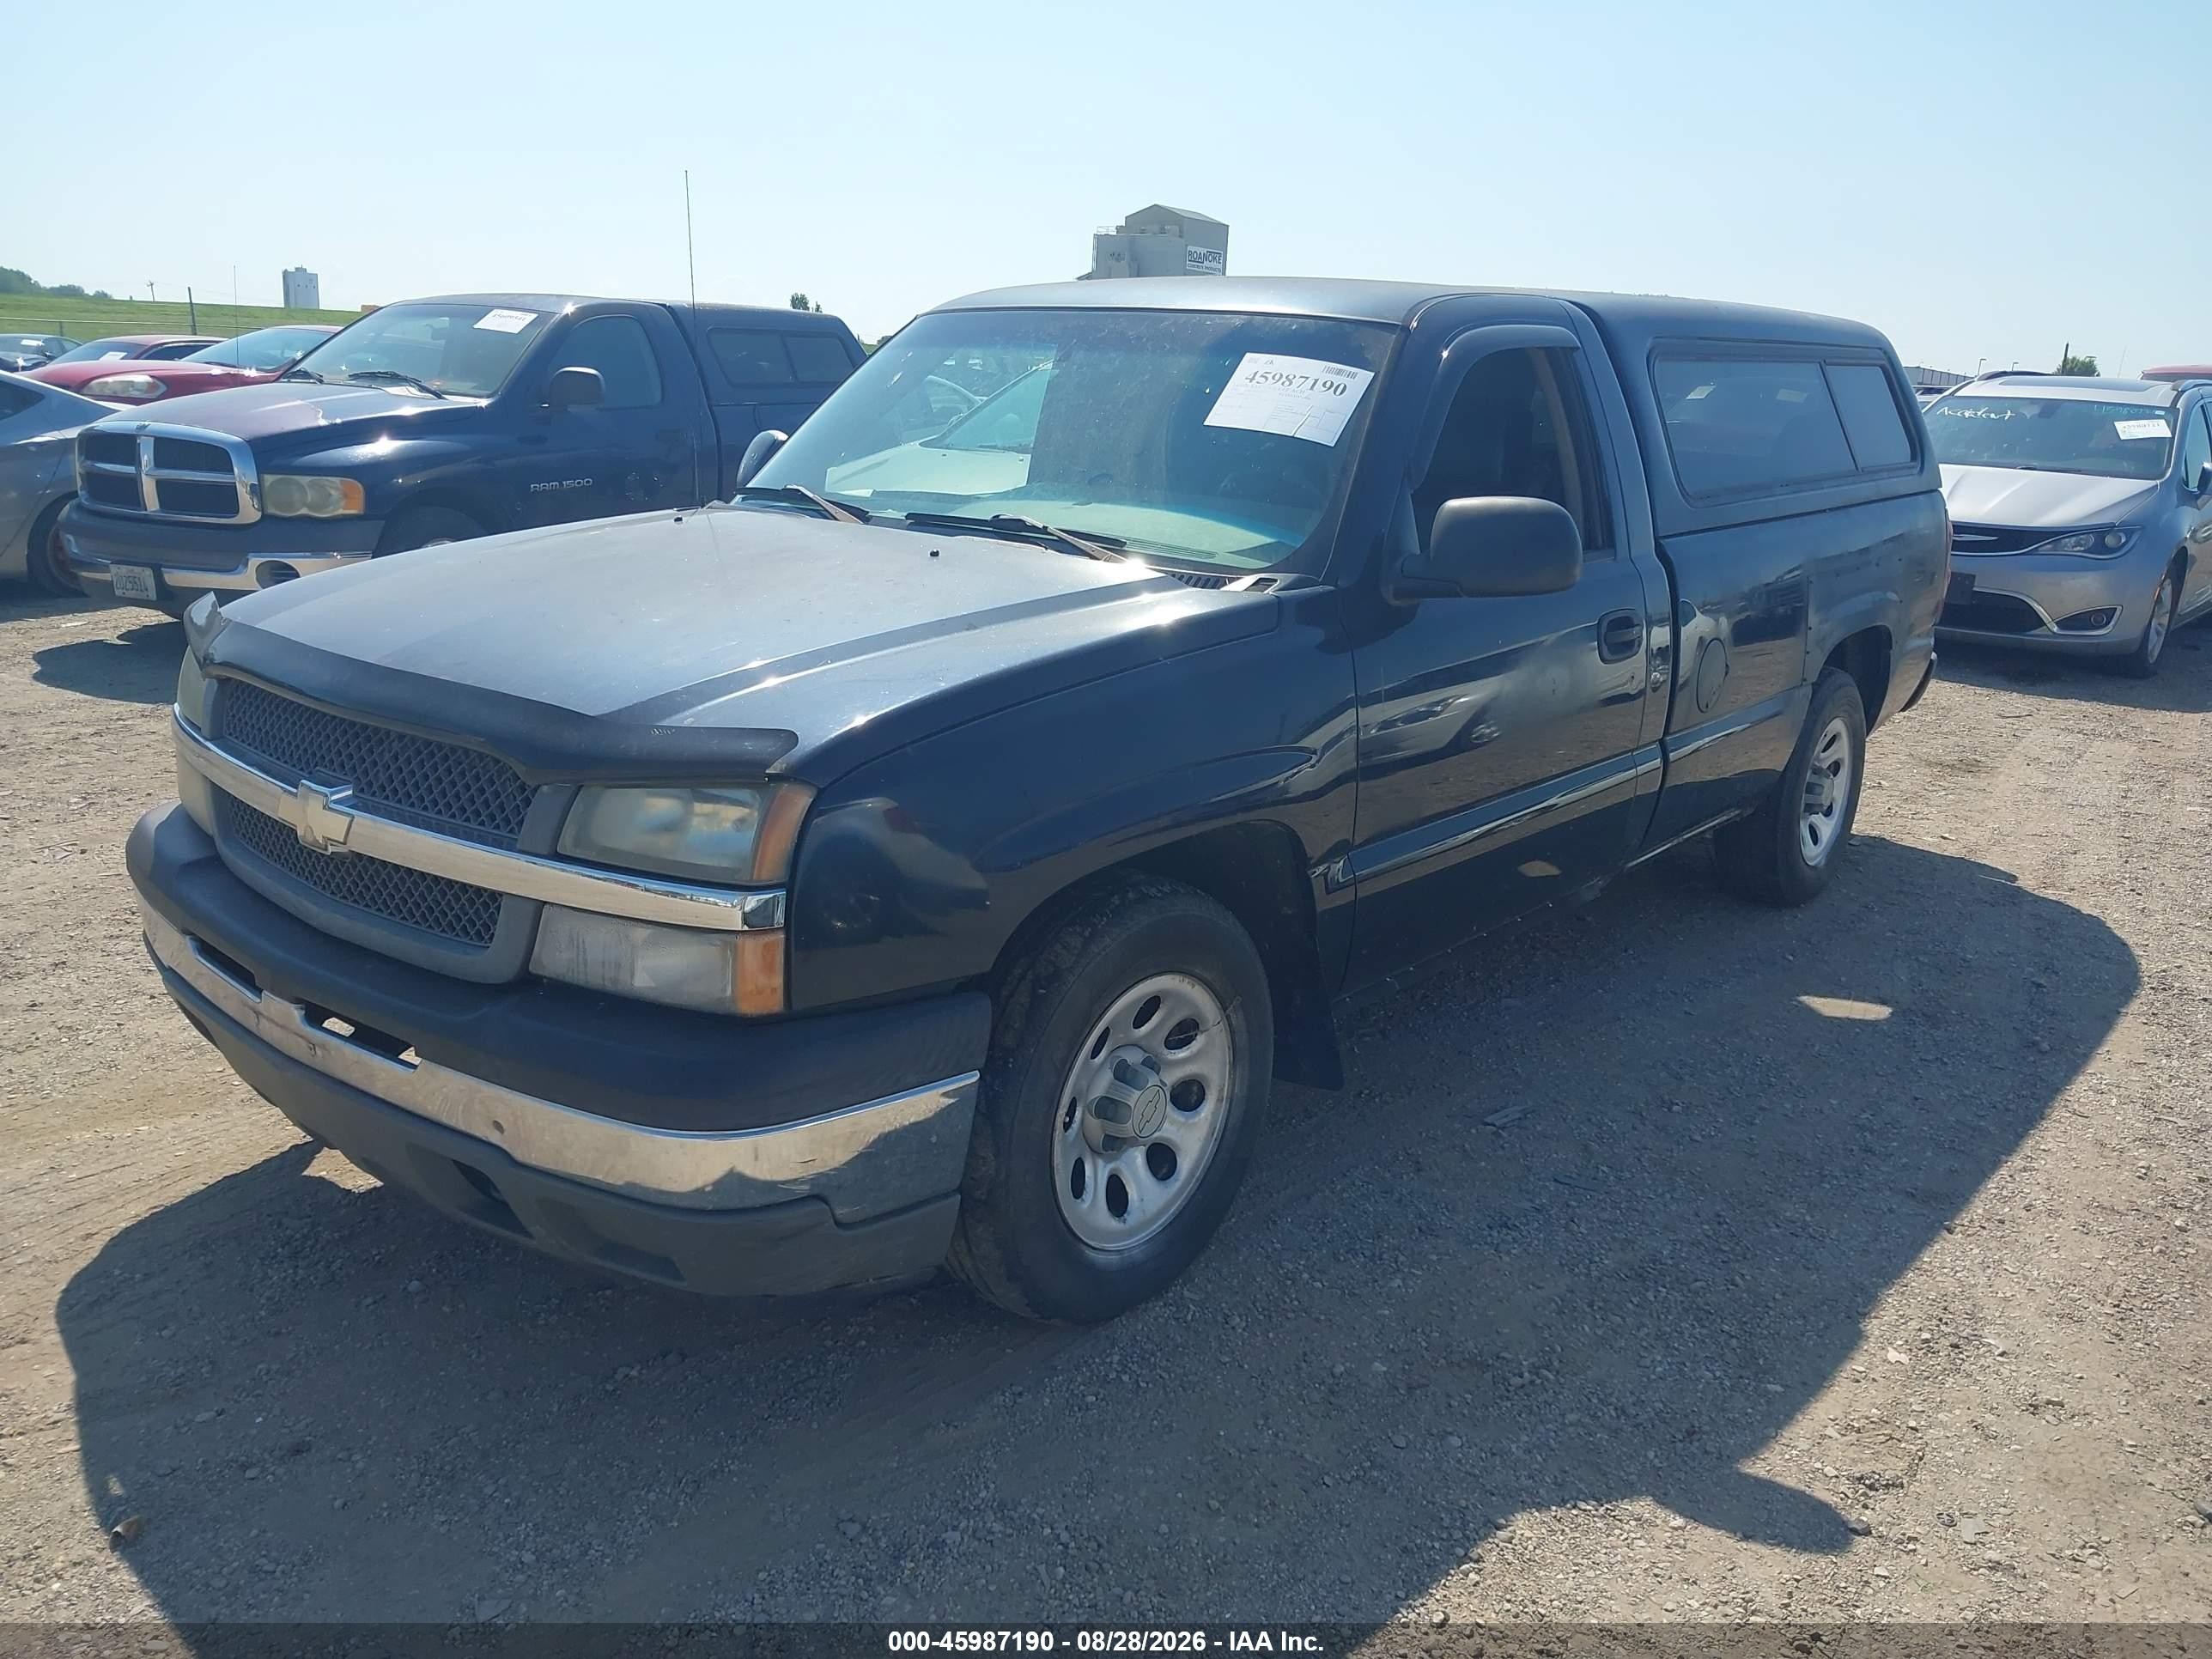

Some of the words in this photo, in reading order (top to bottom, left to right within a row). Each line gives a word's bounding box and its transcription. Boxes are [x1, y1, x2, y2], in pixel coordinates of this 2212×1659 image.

[1188, 250, 1223, 264] ROANOKE
[1245, 370, 1347, 397] 45987190
[531, 482, 559, 492] RAM
[562, 478, 592, 489] 1500
